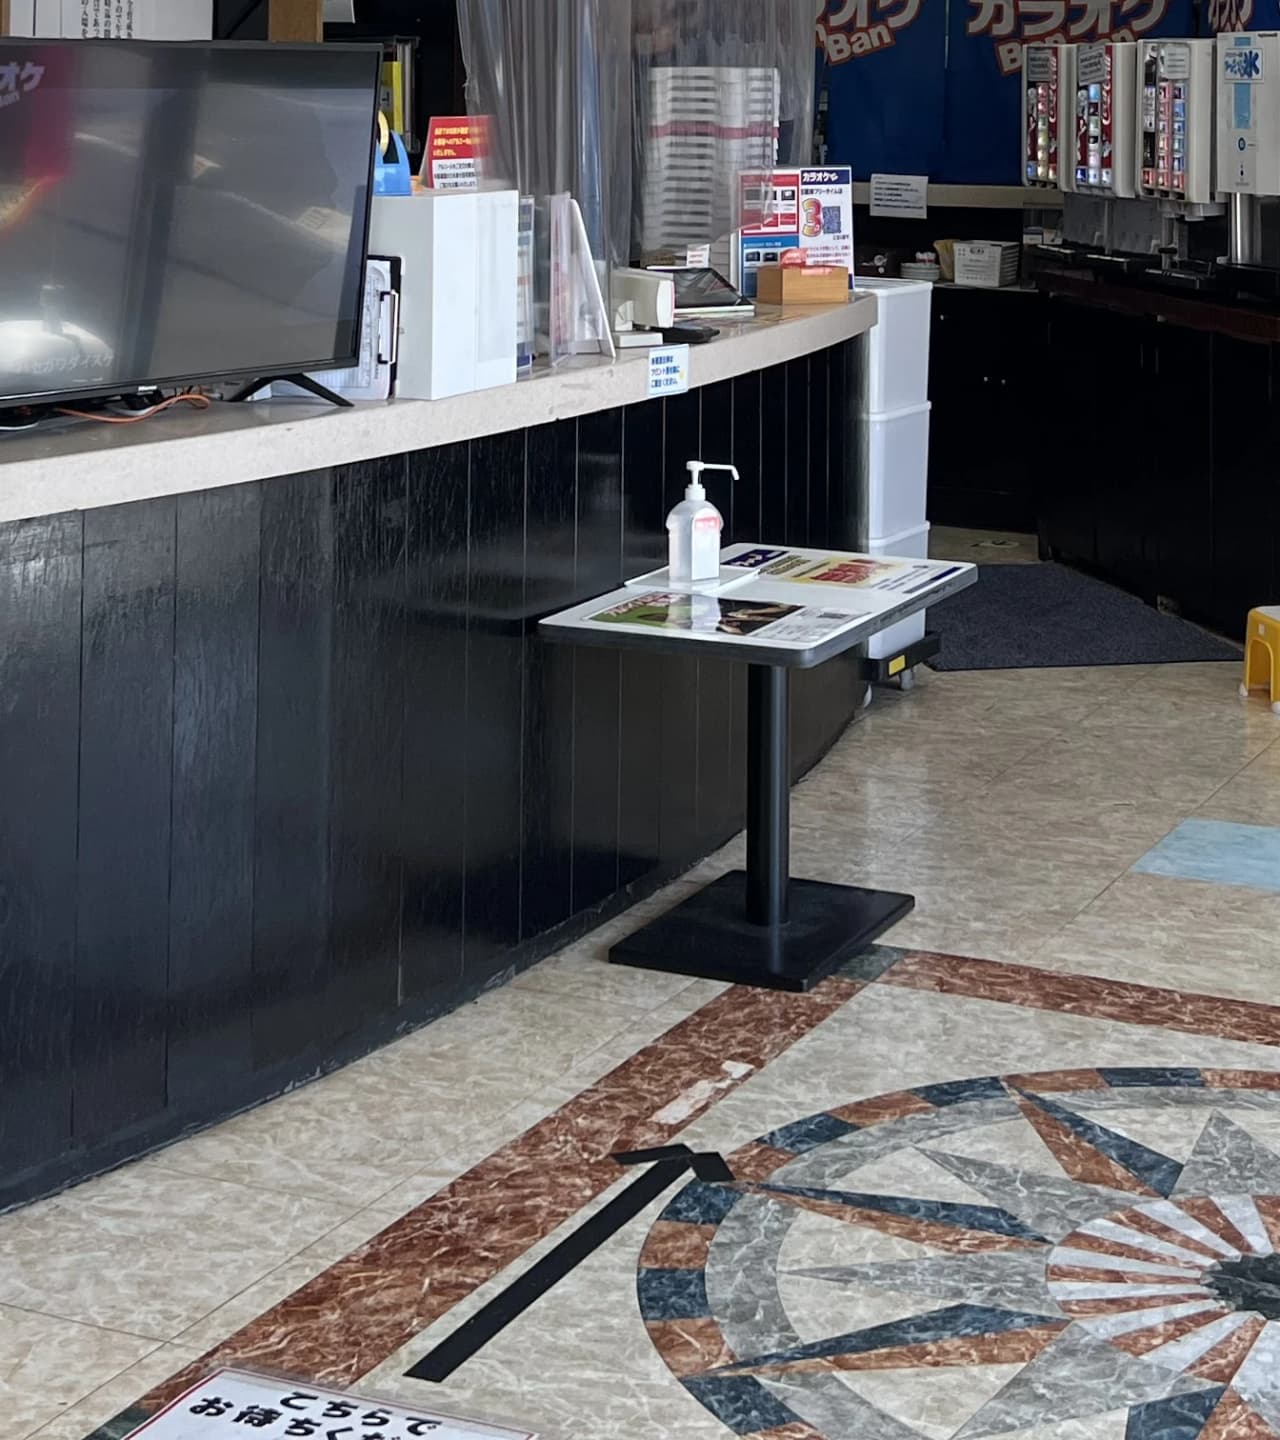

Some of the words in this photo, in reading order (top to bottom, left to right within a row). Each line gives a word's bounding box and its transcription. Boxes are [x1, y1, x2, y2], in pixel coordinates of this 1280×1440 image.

[827, 24, 895, 66] Ban
[803, 172, 828, 182] カラオケ
[279, 1391, 442, 1436] こちらで
